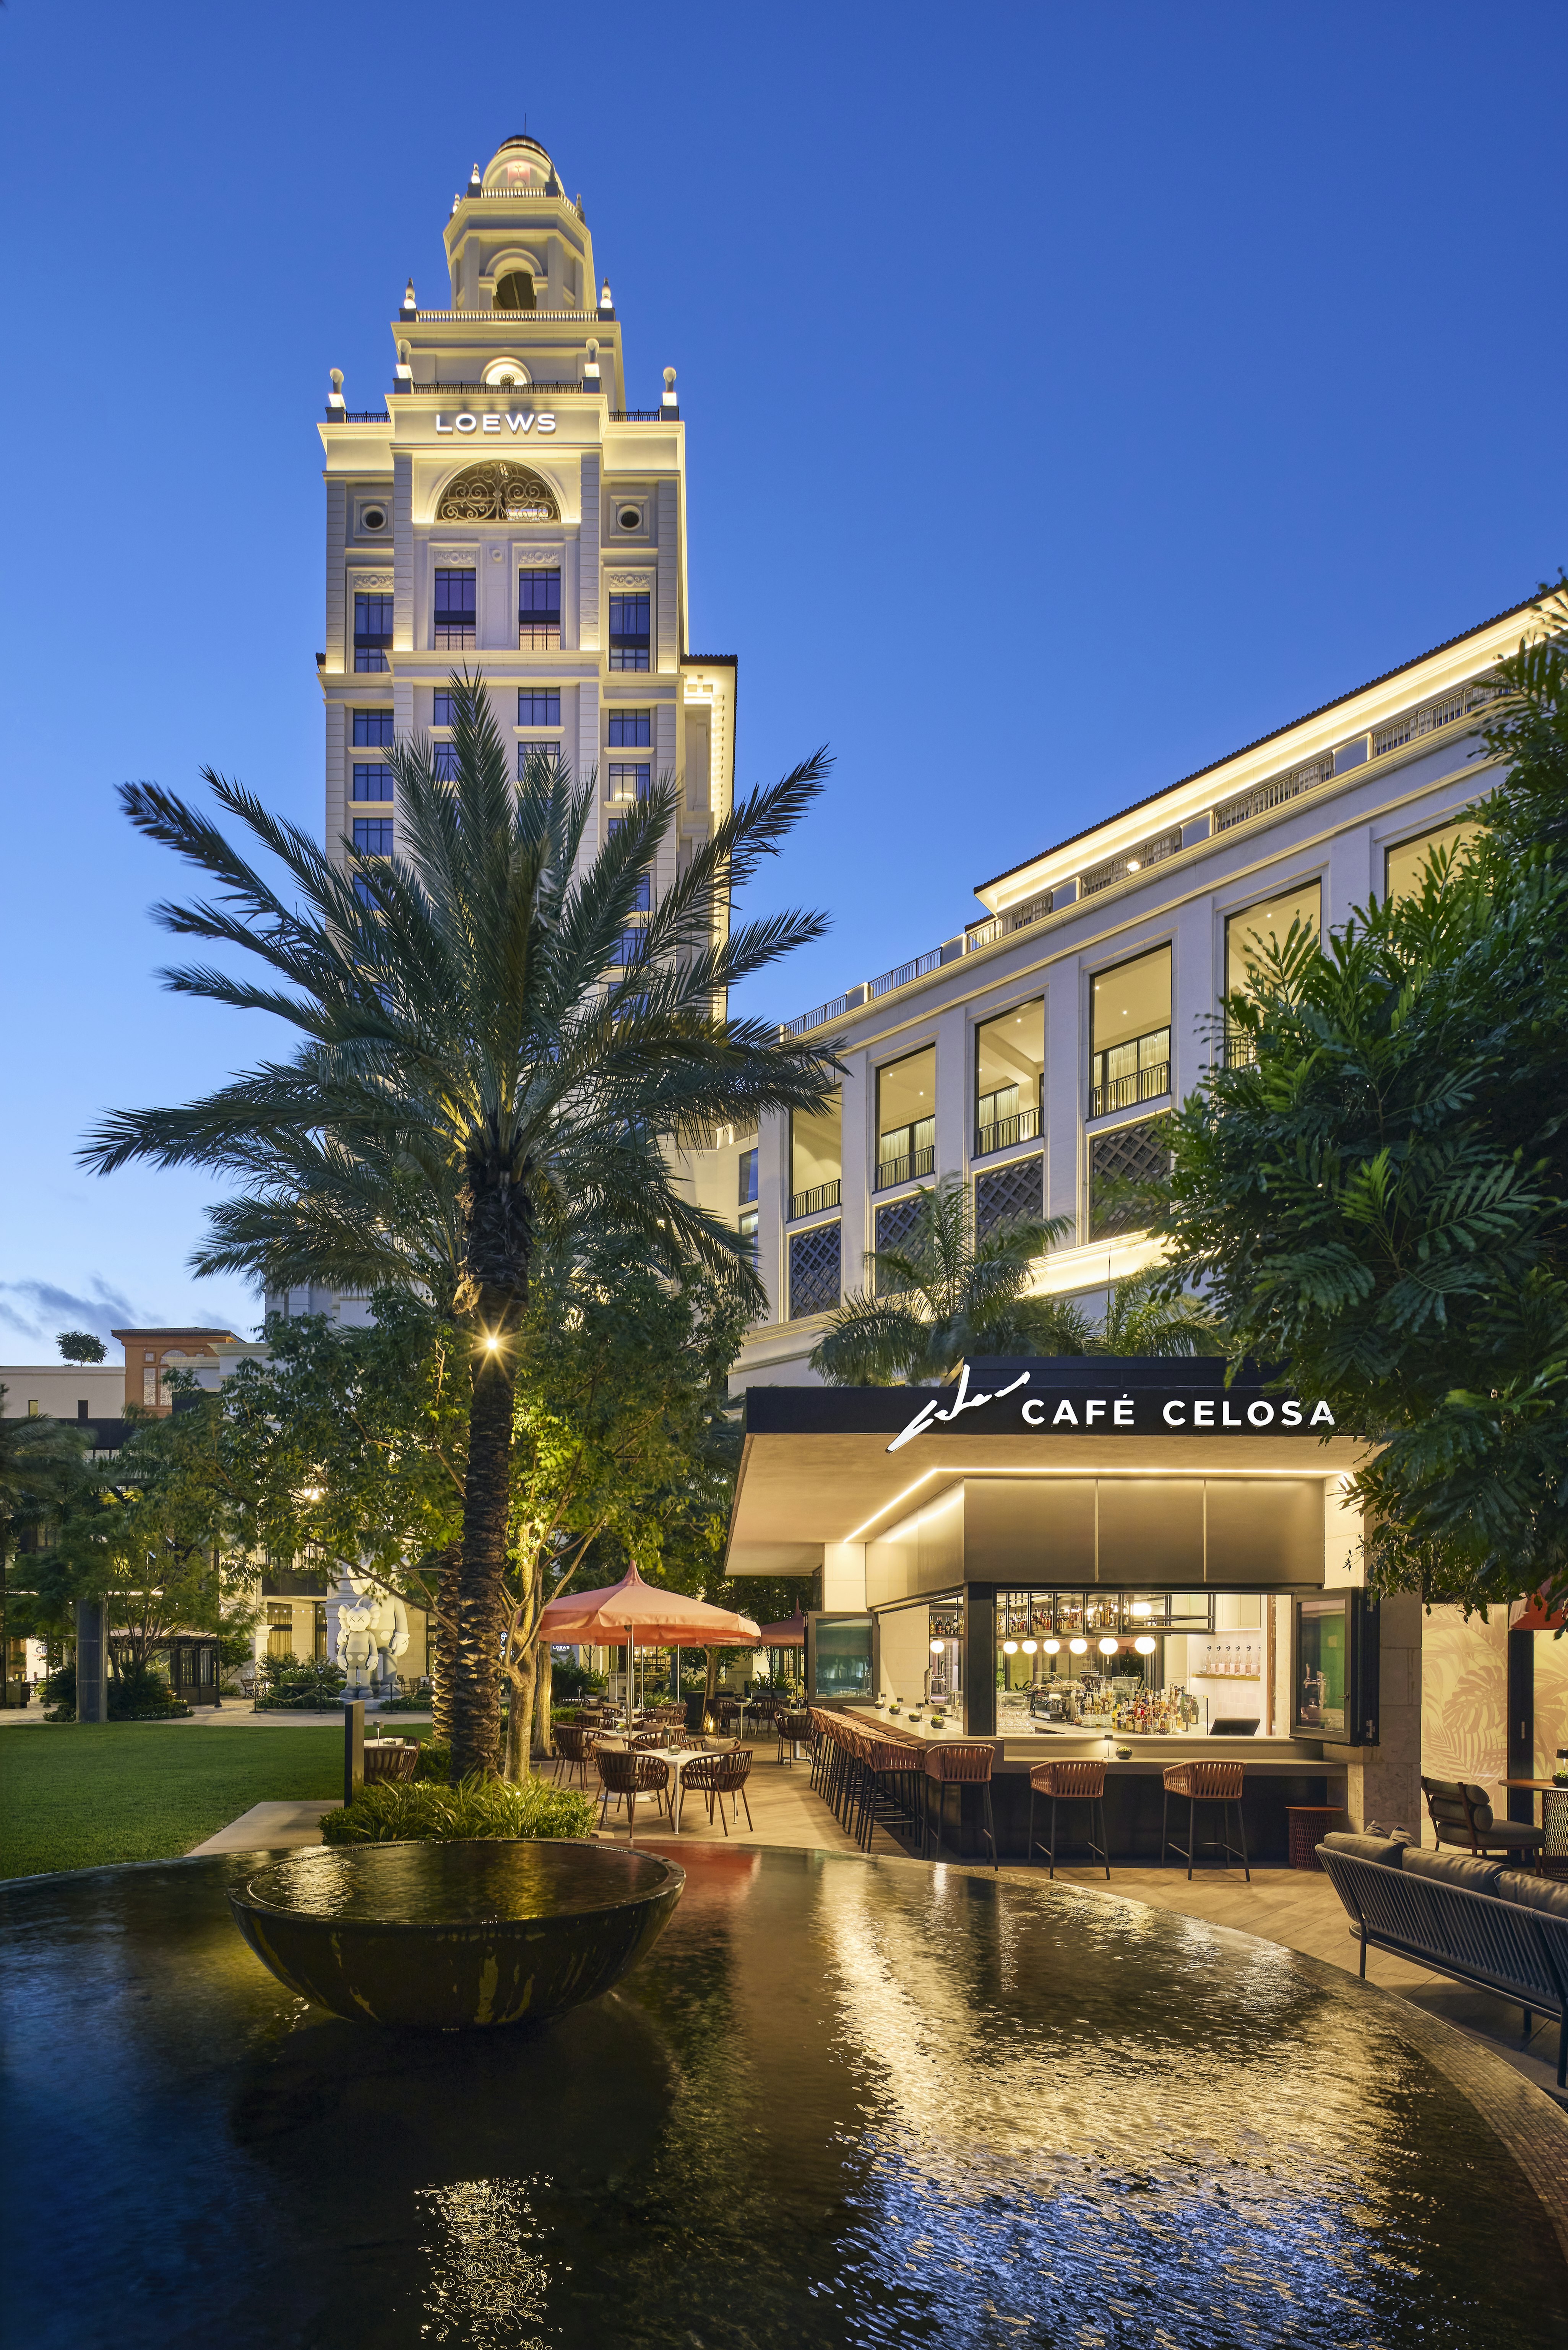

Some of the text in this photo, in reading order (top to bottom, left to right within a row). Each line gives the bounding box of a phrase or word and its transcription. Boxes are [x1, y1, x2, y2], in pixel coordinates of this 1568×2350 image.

[436, 414, 556, 434] LOEWS
[1021, 1394, 1335, 1426] CAFÉ CELOSA
